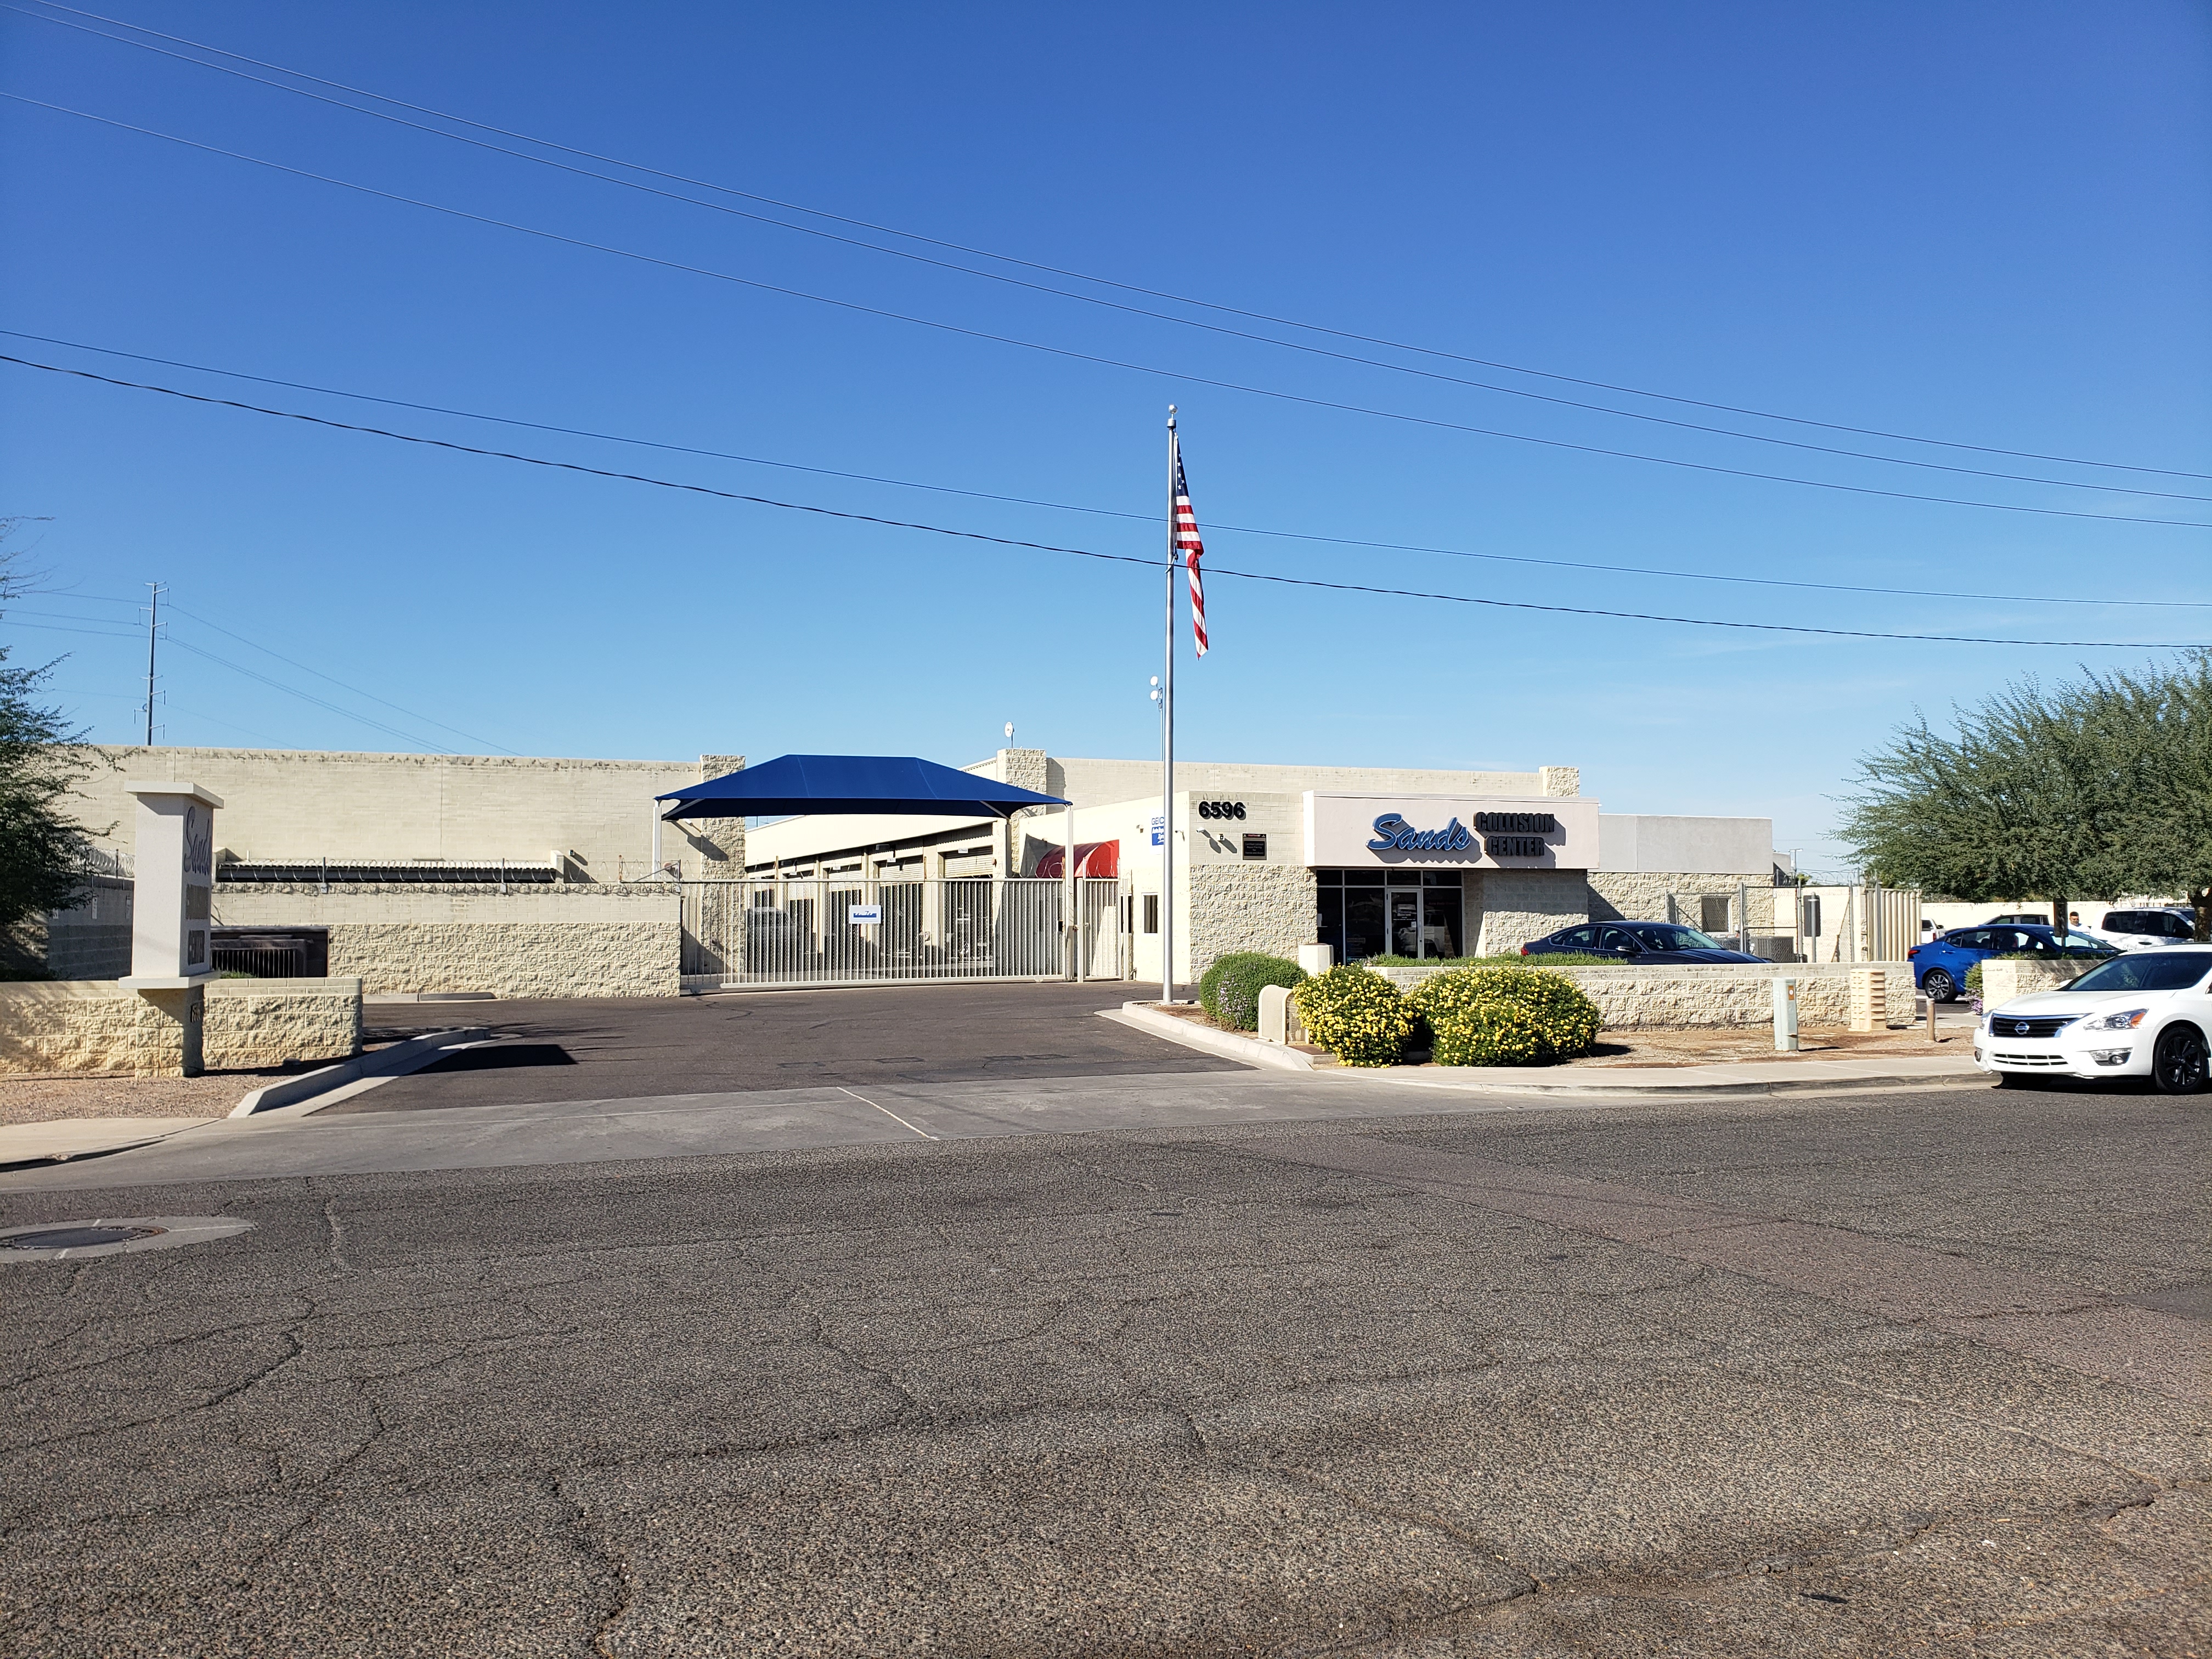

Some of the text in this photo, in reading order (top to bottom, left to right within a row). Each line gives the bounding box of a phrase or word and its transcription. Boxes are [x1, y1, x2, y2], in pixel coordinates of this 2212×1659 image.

[1199, 801, 1246, 819] 6596
[1152, 816, 1164, 825] GEIC
[1474, 812, 1555, 832] COLLISION
[1365, 812, 1471, 851] Sands
[1485, 836, 1545, 856] CENTER
